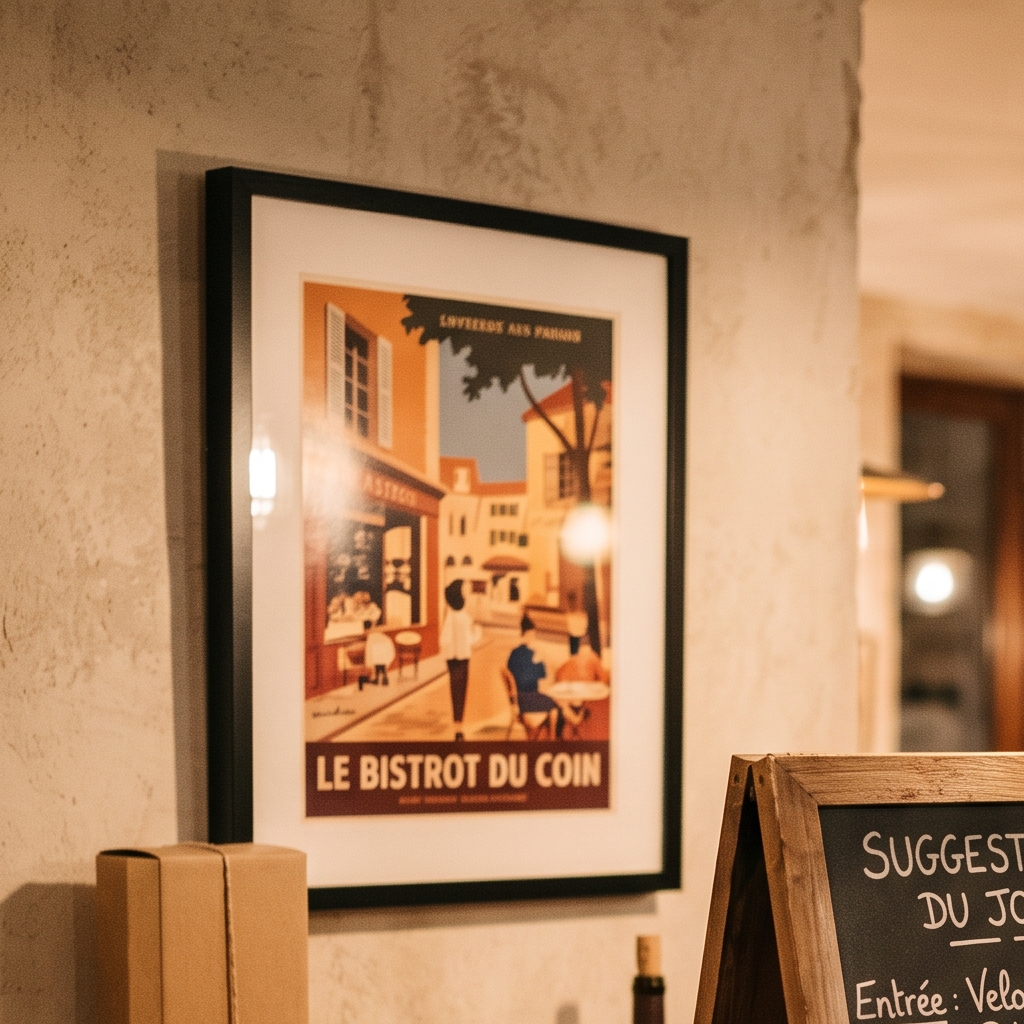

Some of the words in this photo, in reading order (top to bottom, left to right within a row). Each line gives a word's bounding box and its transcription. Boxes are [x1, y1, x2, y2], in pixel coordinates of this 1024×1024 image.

[317, 755, 350, 791] LE
[360, 754, 481, 790] BISTROT
[488, 753, 527, 788] DU
[534, 752, 601, 787] COIN
[918, 892, 968, 929] DU
